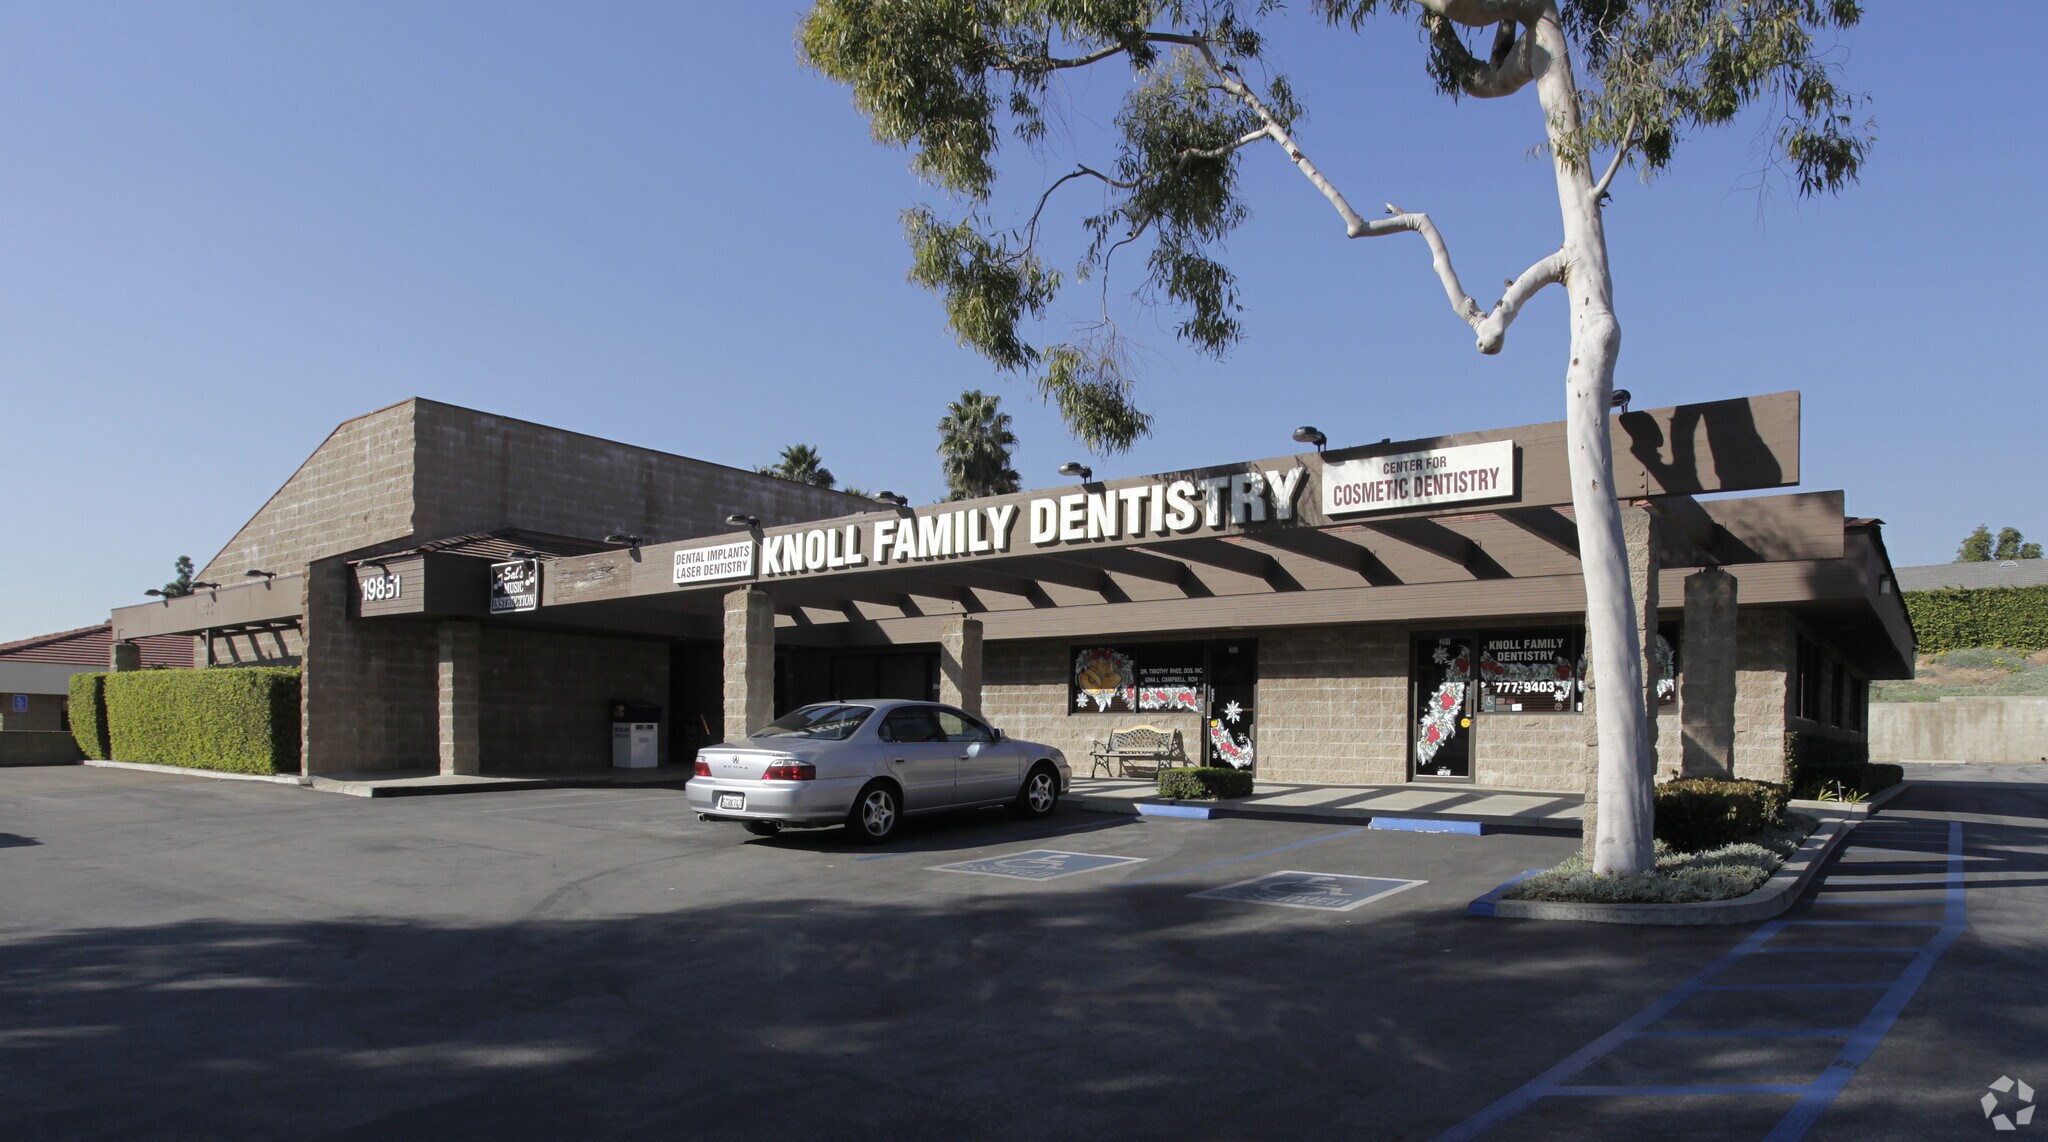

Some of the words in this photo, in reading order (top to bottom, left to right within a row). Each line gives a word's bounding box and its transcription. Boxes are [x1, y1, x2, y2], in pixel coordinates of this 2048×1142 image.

[1383, 458, 1422, 474] CENTER
[1426, 456, 1447, 469] FOR
[1333, 478, 1409, 506] COSMETIC
[1413, 467, 1500, 498] DENTISTRY
[762, 524, 863, 575] KNOLL
[873, 504, 1015, 562] FAMILY
[1030, 466, 1304, 544] DENTISTRY
[676, 551, 705, 565] DENTAL
[707, 545, 750, 562] IMPLANTS
[503, 565, 524, 581] Sal's
[676, 565, 702, 579] LASER
[703, 560, 748, 576] DENTISTRY
[362, 574, 401, 601] 19851
[503, 581, 524, 594] MUSIC
[492, 594, 534, 609] INSTRUCTION
[1489, 640, 1520, 650] KNOLL
[1523, 638, 1564, 649] FAMILY
[1497, 650, 1555, 661] DENTISTRY
[1495, 681, 1555, 693] 777-9403
